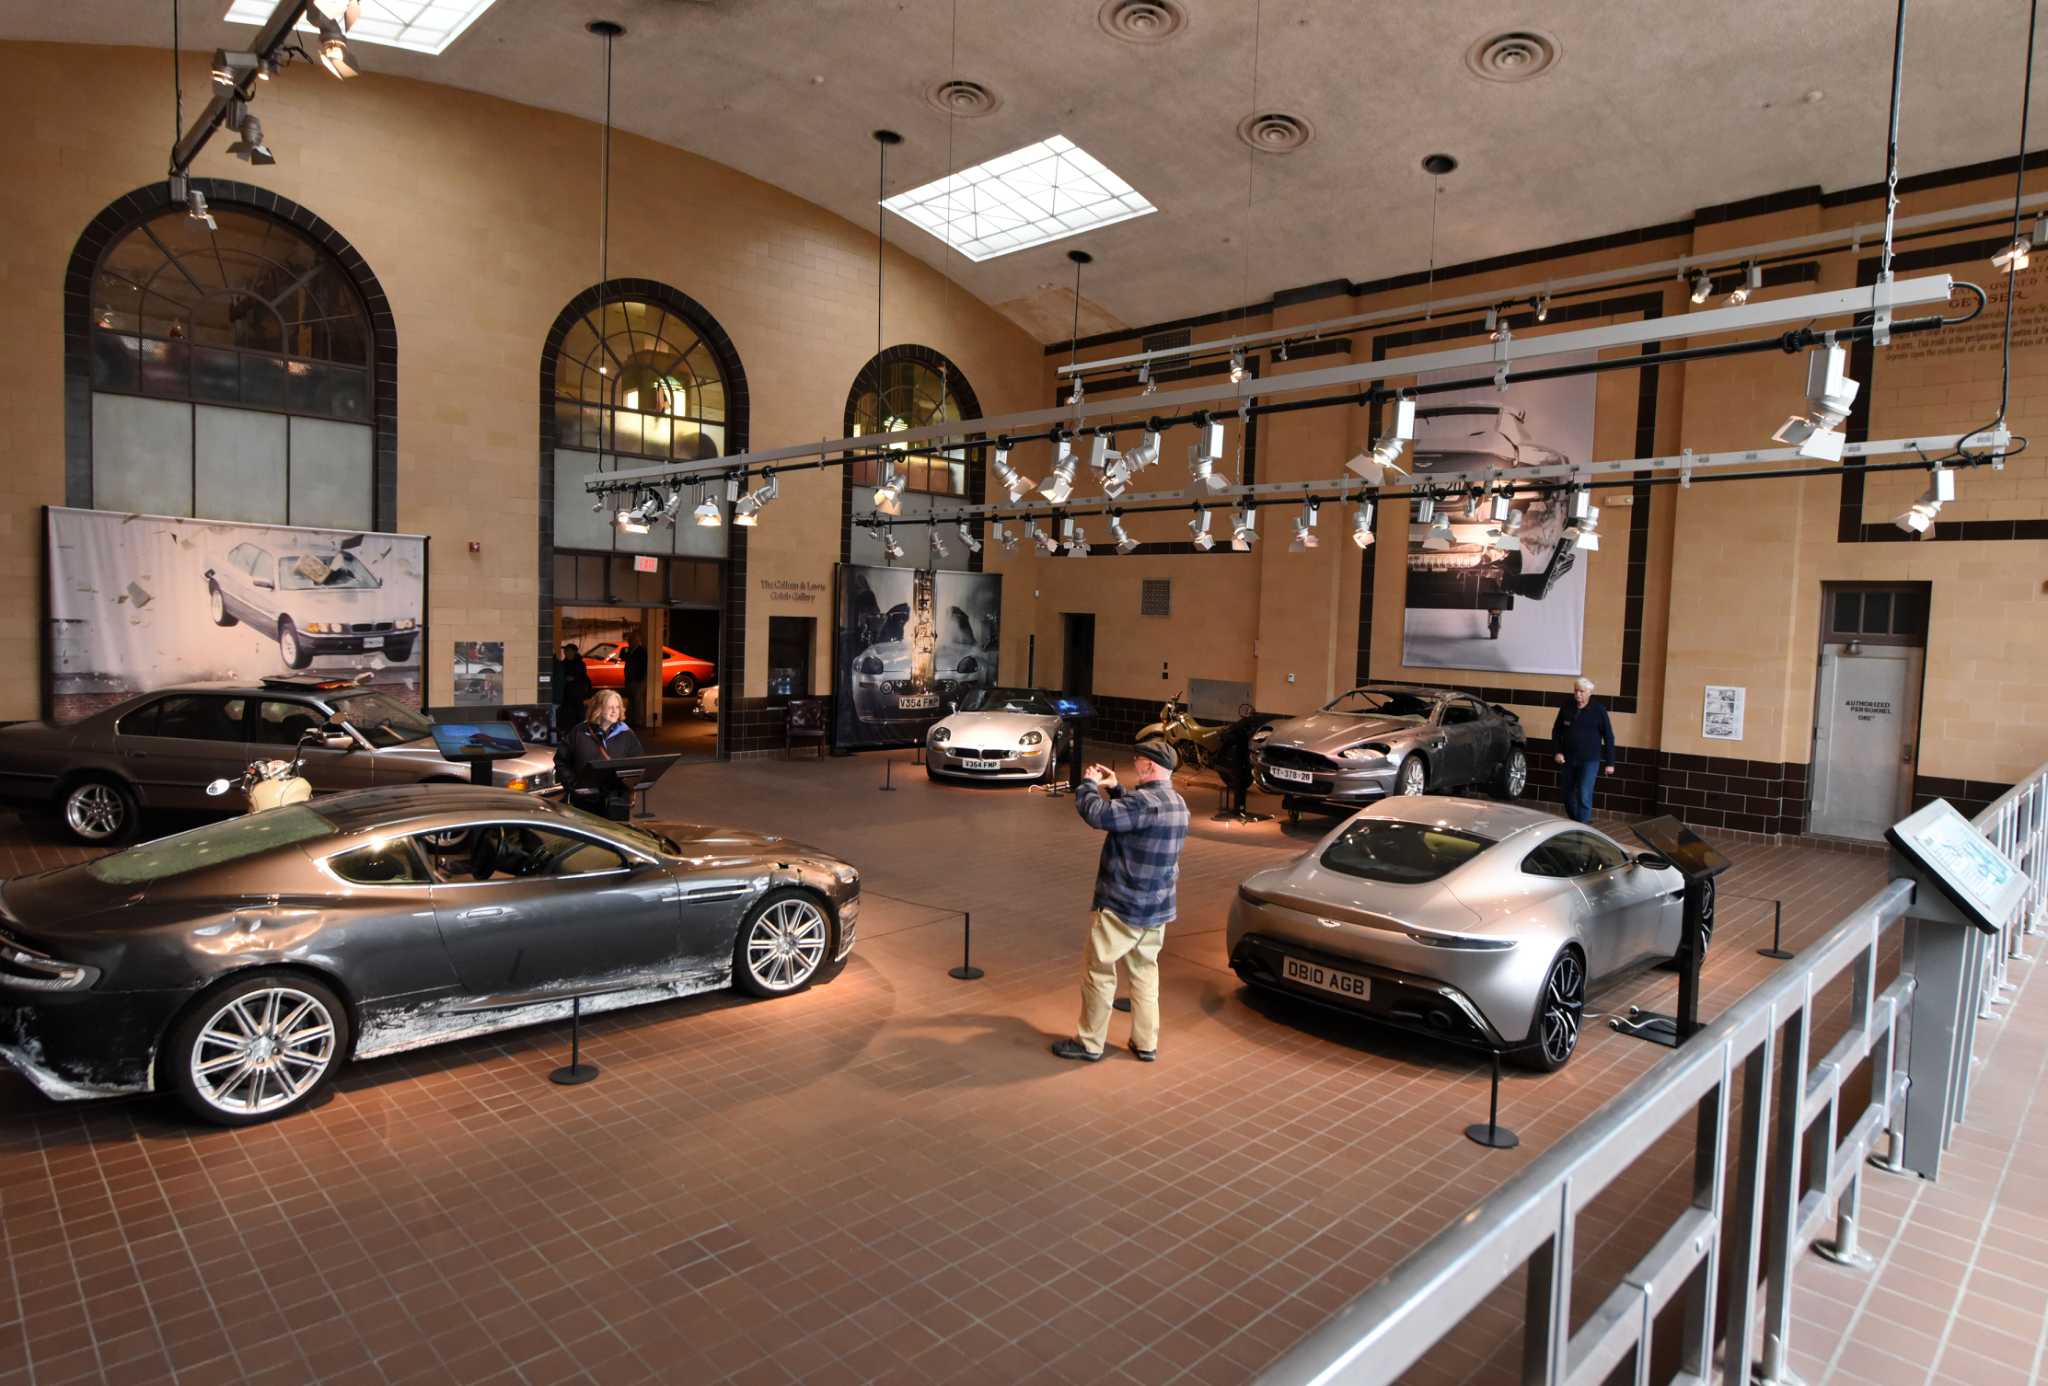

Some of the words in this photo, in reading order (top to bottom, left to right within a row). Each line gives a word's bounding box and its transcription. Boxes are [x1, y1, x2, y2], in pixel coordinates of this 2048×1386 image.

[900, 696, 921, 708] V354
[1288, 961, 1324, 985] DB10
[1329, 973, 1364, 995] AGB
